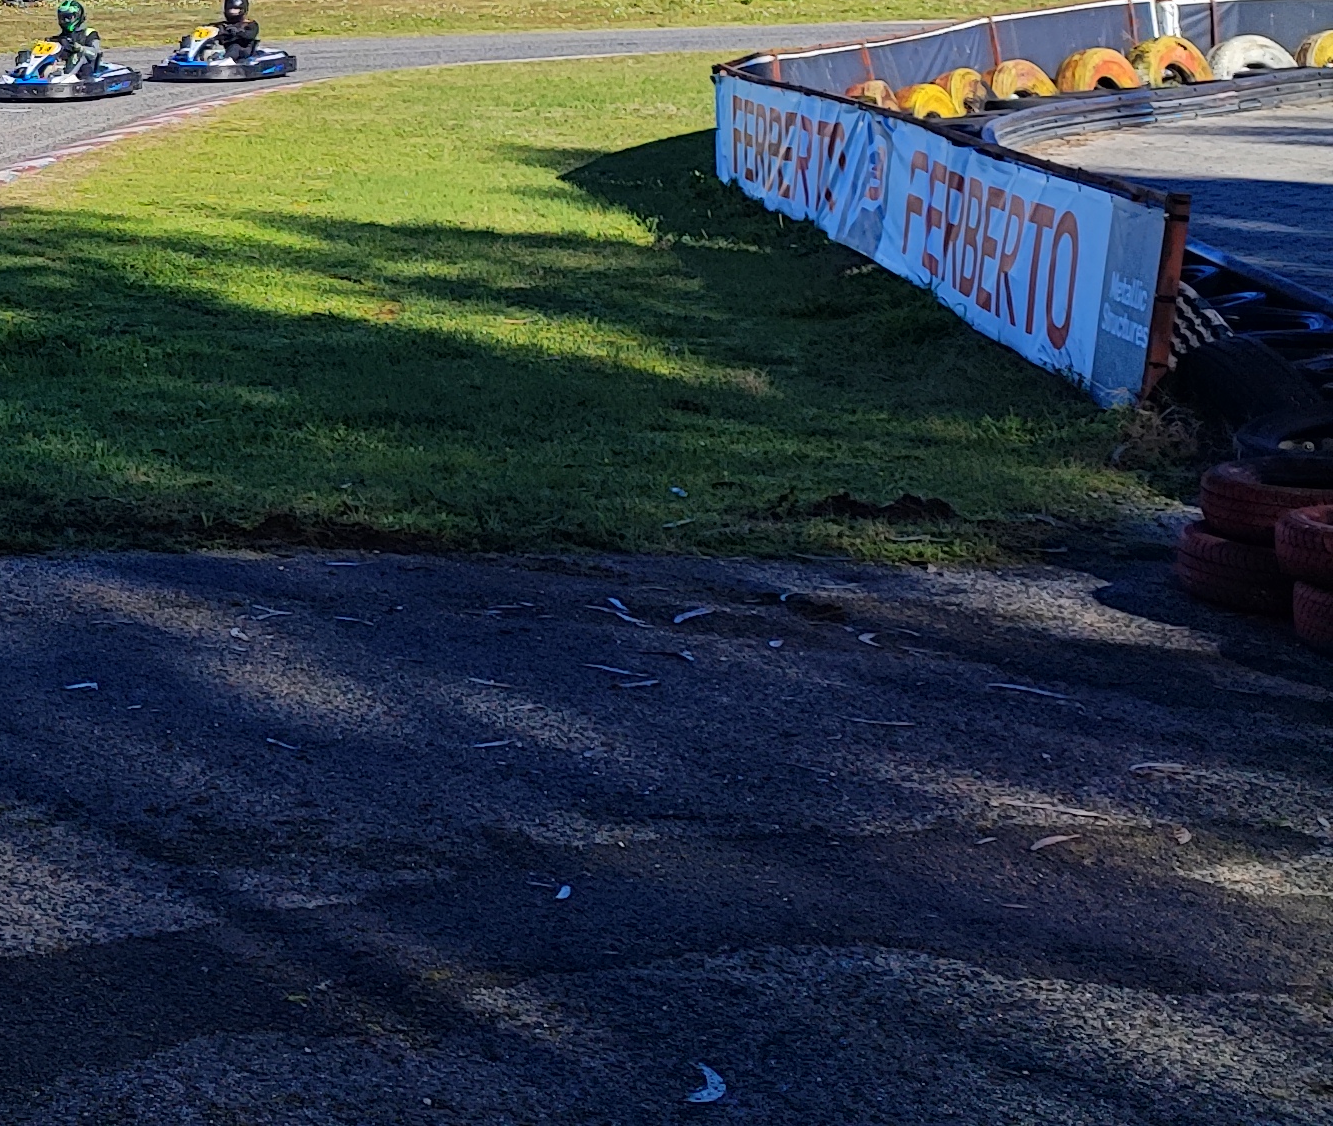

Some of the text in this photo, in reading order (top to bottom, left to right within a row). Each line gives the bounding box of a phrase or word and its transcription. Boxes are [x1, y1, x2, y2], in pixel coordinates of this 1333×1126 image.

[732, 94, 847, 213] FERBERTO
[901, 149, 1079, 351] FERBERTO
[1109, 270, 1148, 312] Metallic
[1101, 302, 1148, 349] Structures
